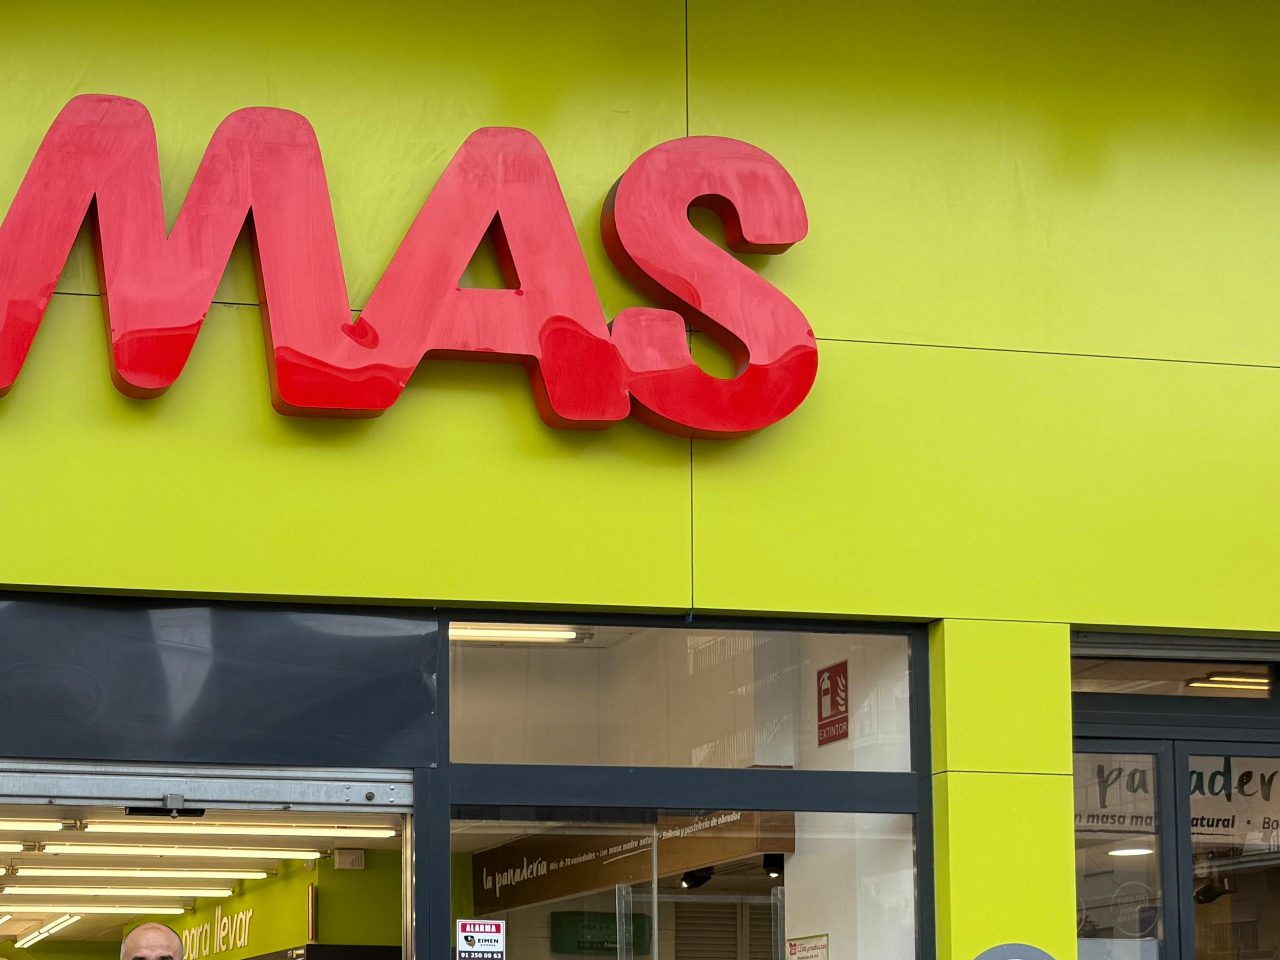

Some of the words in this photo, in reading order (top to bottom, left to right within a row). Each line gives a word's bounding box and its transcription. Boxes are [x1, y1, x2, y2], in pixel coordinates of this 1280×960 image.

[819, 722, 847, 740] EXTINTOR
[1086, 813, 1126, 826] masa
[1190, 815, 1236, 829] atural
[495, 857, 548, 898] panadería
[213, 904, 254, 954] llevar
[465, 923, 497, 933] ALARMA
